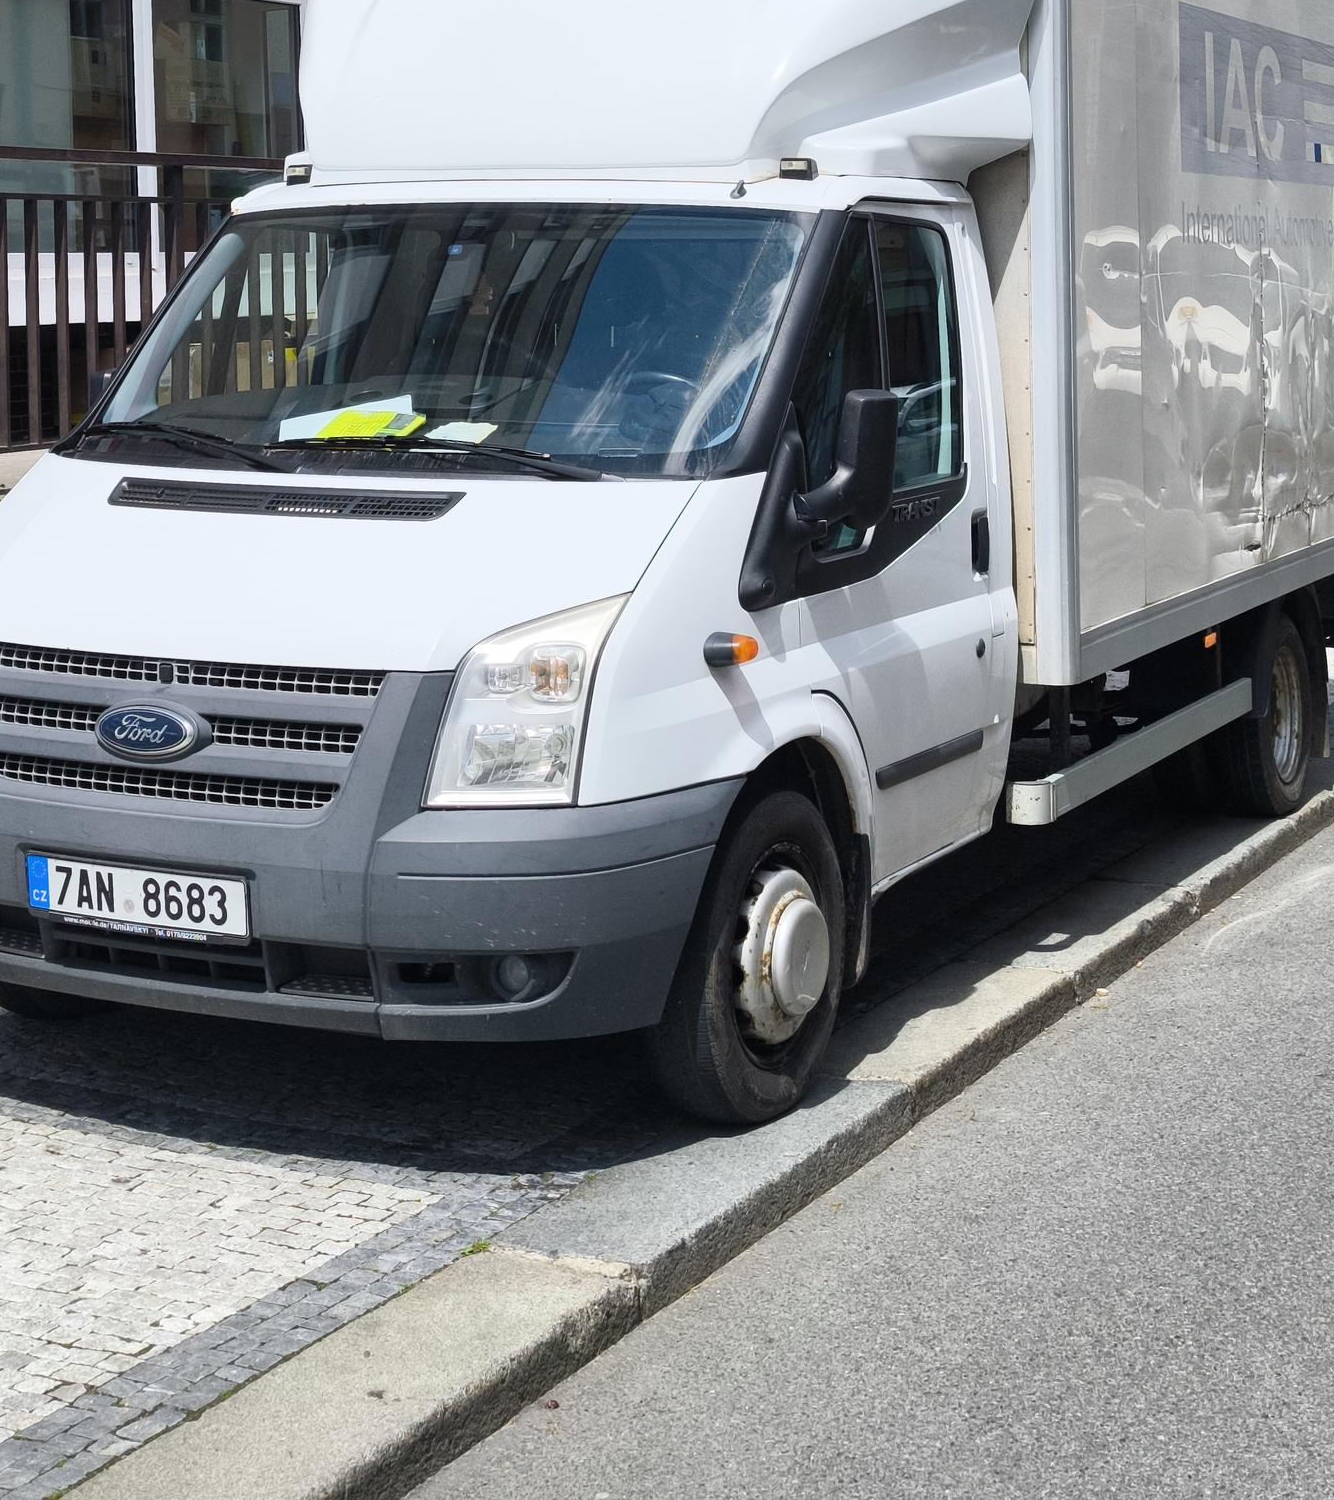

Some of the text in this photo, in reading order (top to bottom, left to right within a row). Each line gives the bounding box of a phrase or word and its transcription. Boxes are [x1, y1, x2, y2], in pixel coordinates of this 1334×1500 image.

[1203, 30, 1285, 163] IAC
[1181, 201, 1268, 245] International
[1273, 206, 1334, 247] Automotive
[114, 714, 168, 744] Ford
[33, 888, 47, 902] CZ
[55, 865, 228, 926] 7AN 8683
